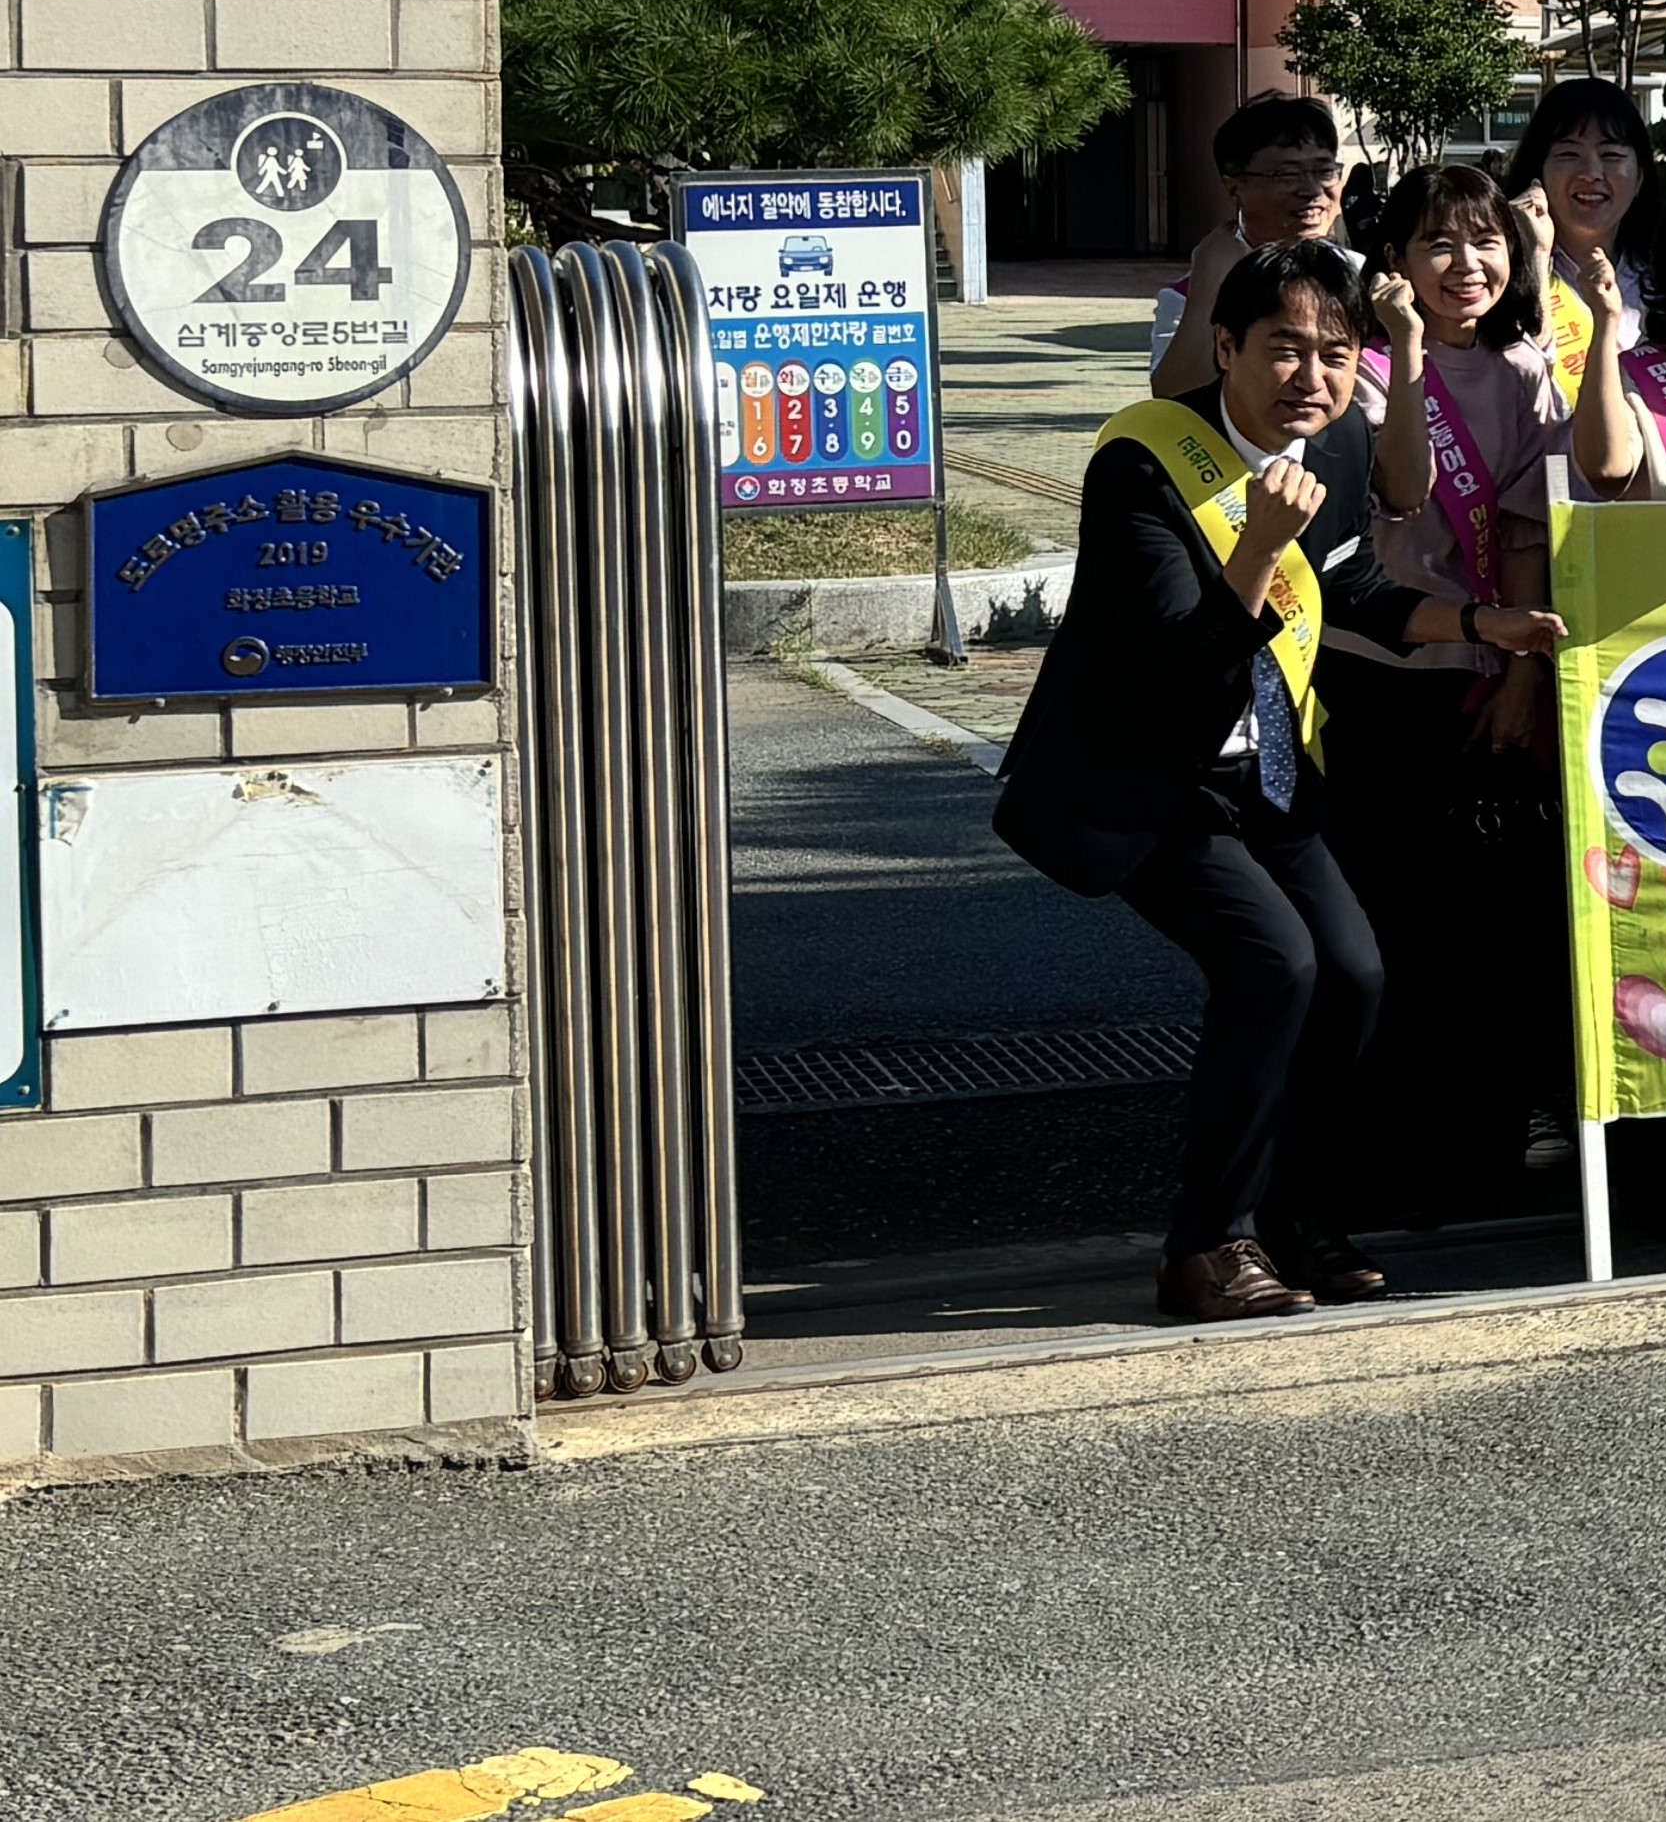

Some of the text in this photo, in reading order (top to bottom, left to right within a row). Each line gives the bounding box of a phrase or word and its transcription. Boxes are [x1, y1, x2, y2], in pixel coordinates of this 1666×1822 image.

[702, 190, 906, 221] 에너지 절약에 동참합시다.
[191, 217, 392, 303] 24
[709, 280, 906, 312] 차량 요일제 운행
[177, 320, 408, 348] 삼계중앙로5번길
[754, 321, 867, 348] 운행제한차량
[201, 355, 387, 377] Samgyejungang-ro 5beon-gil
[753, 396, 910, 419] 1 2 3 4 5
[753, 430, 911, 456] 6 7 8 9 0
[768, 474, 891, 496] 화정초등학교
[119, 488, 465, 592] 도로명주소 활용 우수기관
[259, 541, 329, 566] 2019
[225, 585, 361, 611] 화정초등학교
